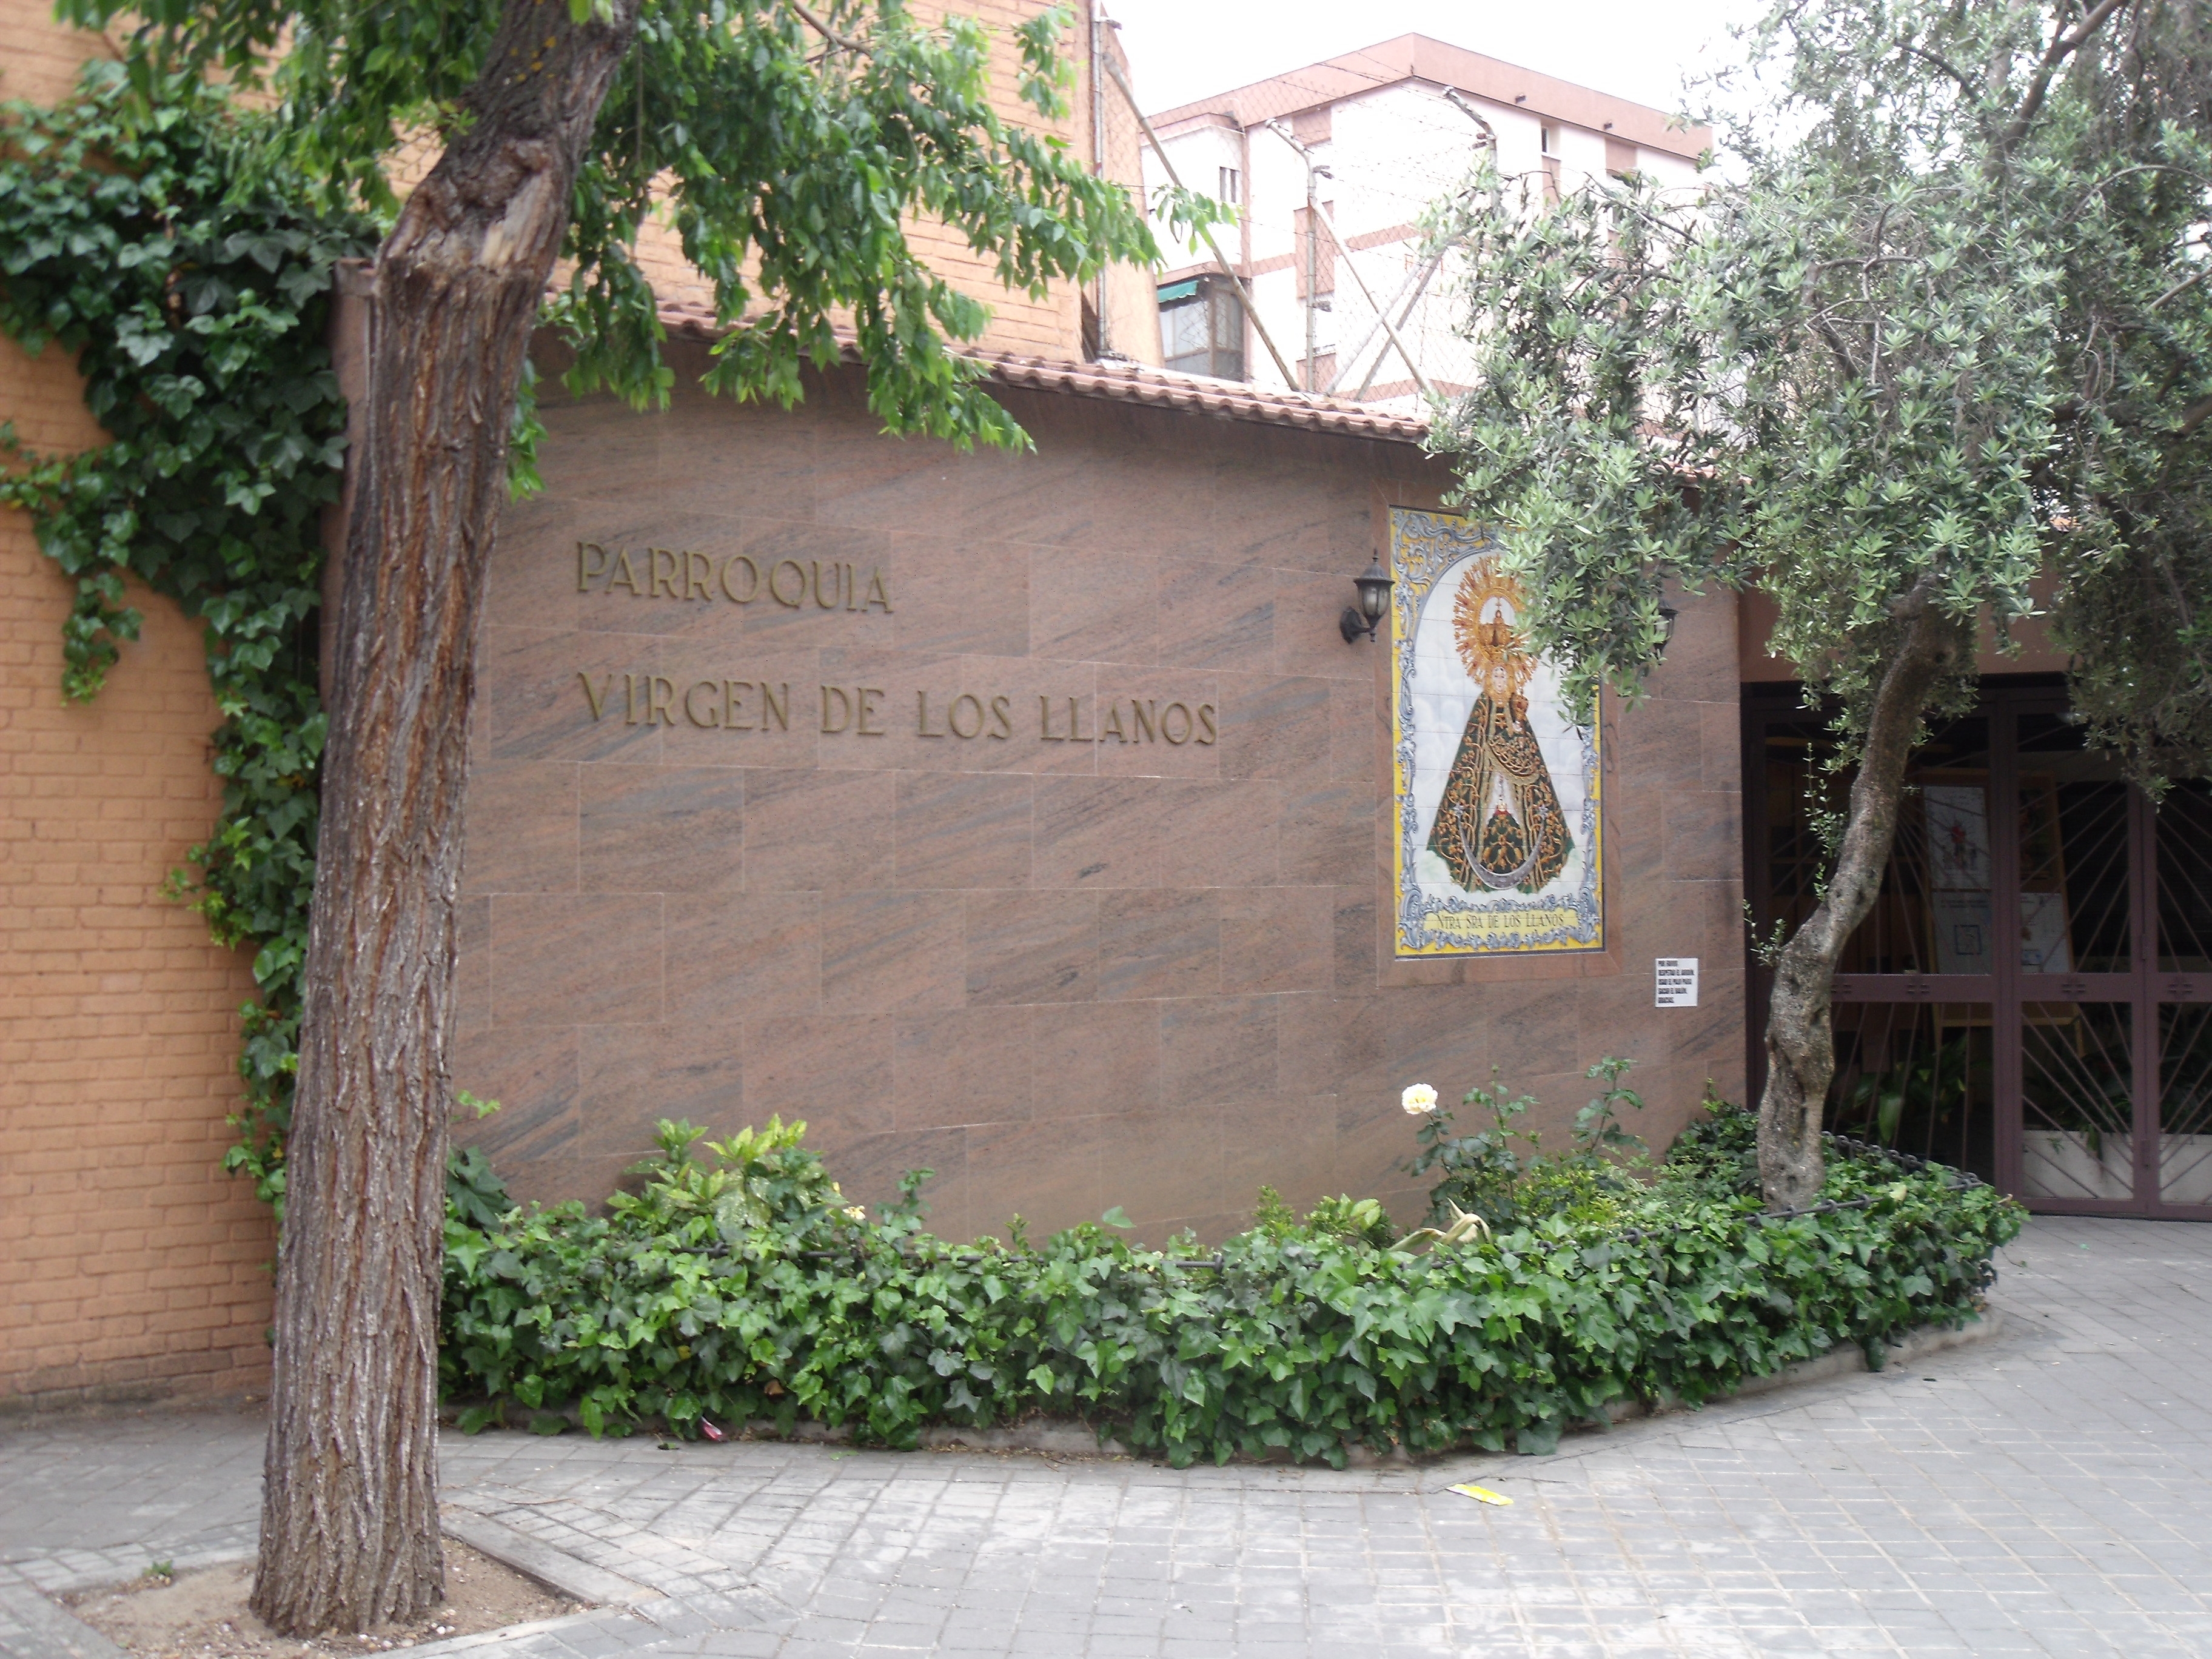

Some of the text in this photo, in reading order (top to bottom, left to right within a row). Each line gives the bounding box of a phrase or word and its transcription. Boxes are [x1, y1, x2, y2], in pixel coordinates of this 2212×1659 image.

[577, 541, 894, 614] PARROQUIA
[578, 671, 1216, 745] VIRGEN DE LOS LLANOS
[1466, 913, 1483, 928] SRA
[1488, 914, 1500, 928] DE
[1504, 913, 1521, 928] LOS
[1526, 913, 1564, 927] LLANOS
